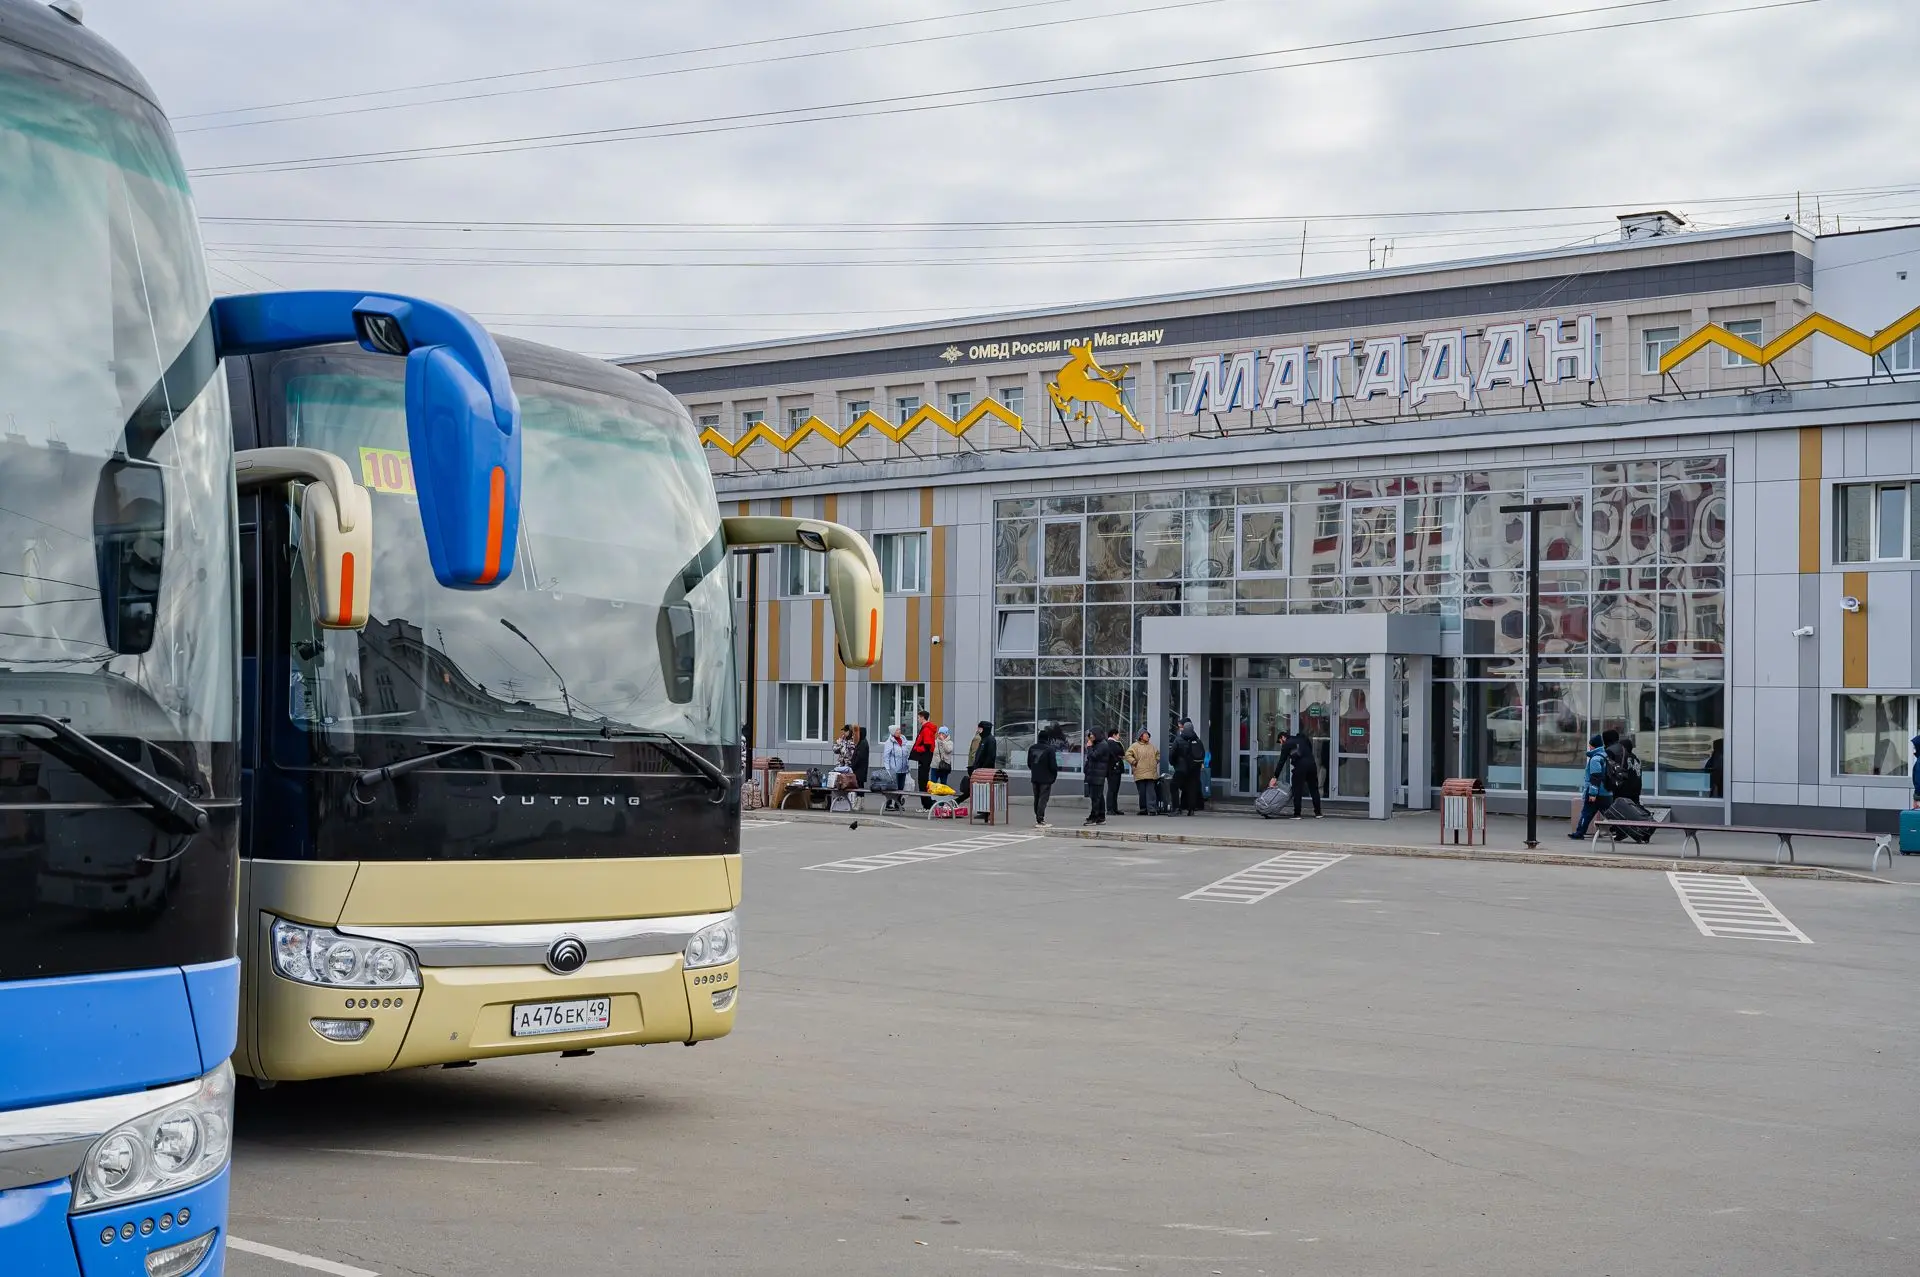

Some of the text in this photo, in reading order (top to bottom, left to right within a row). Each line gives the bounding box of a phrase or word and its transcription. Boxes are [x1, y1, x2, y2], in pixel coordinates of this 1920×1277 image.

[969, 343, 1010, 360] ОМВД
[1012, 340, 1061, 356] России
[1063, 338, 1080, 351] по
[1094, 328, 1164, 347] Магадану
[1182, 313, 1597, 416] МАГАДАН
[492, 795, 640, 806] YUTONG
[589, 1001, 605, 1016] 49
